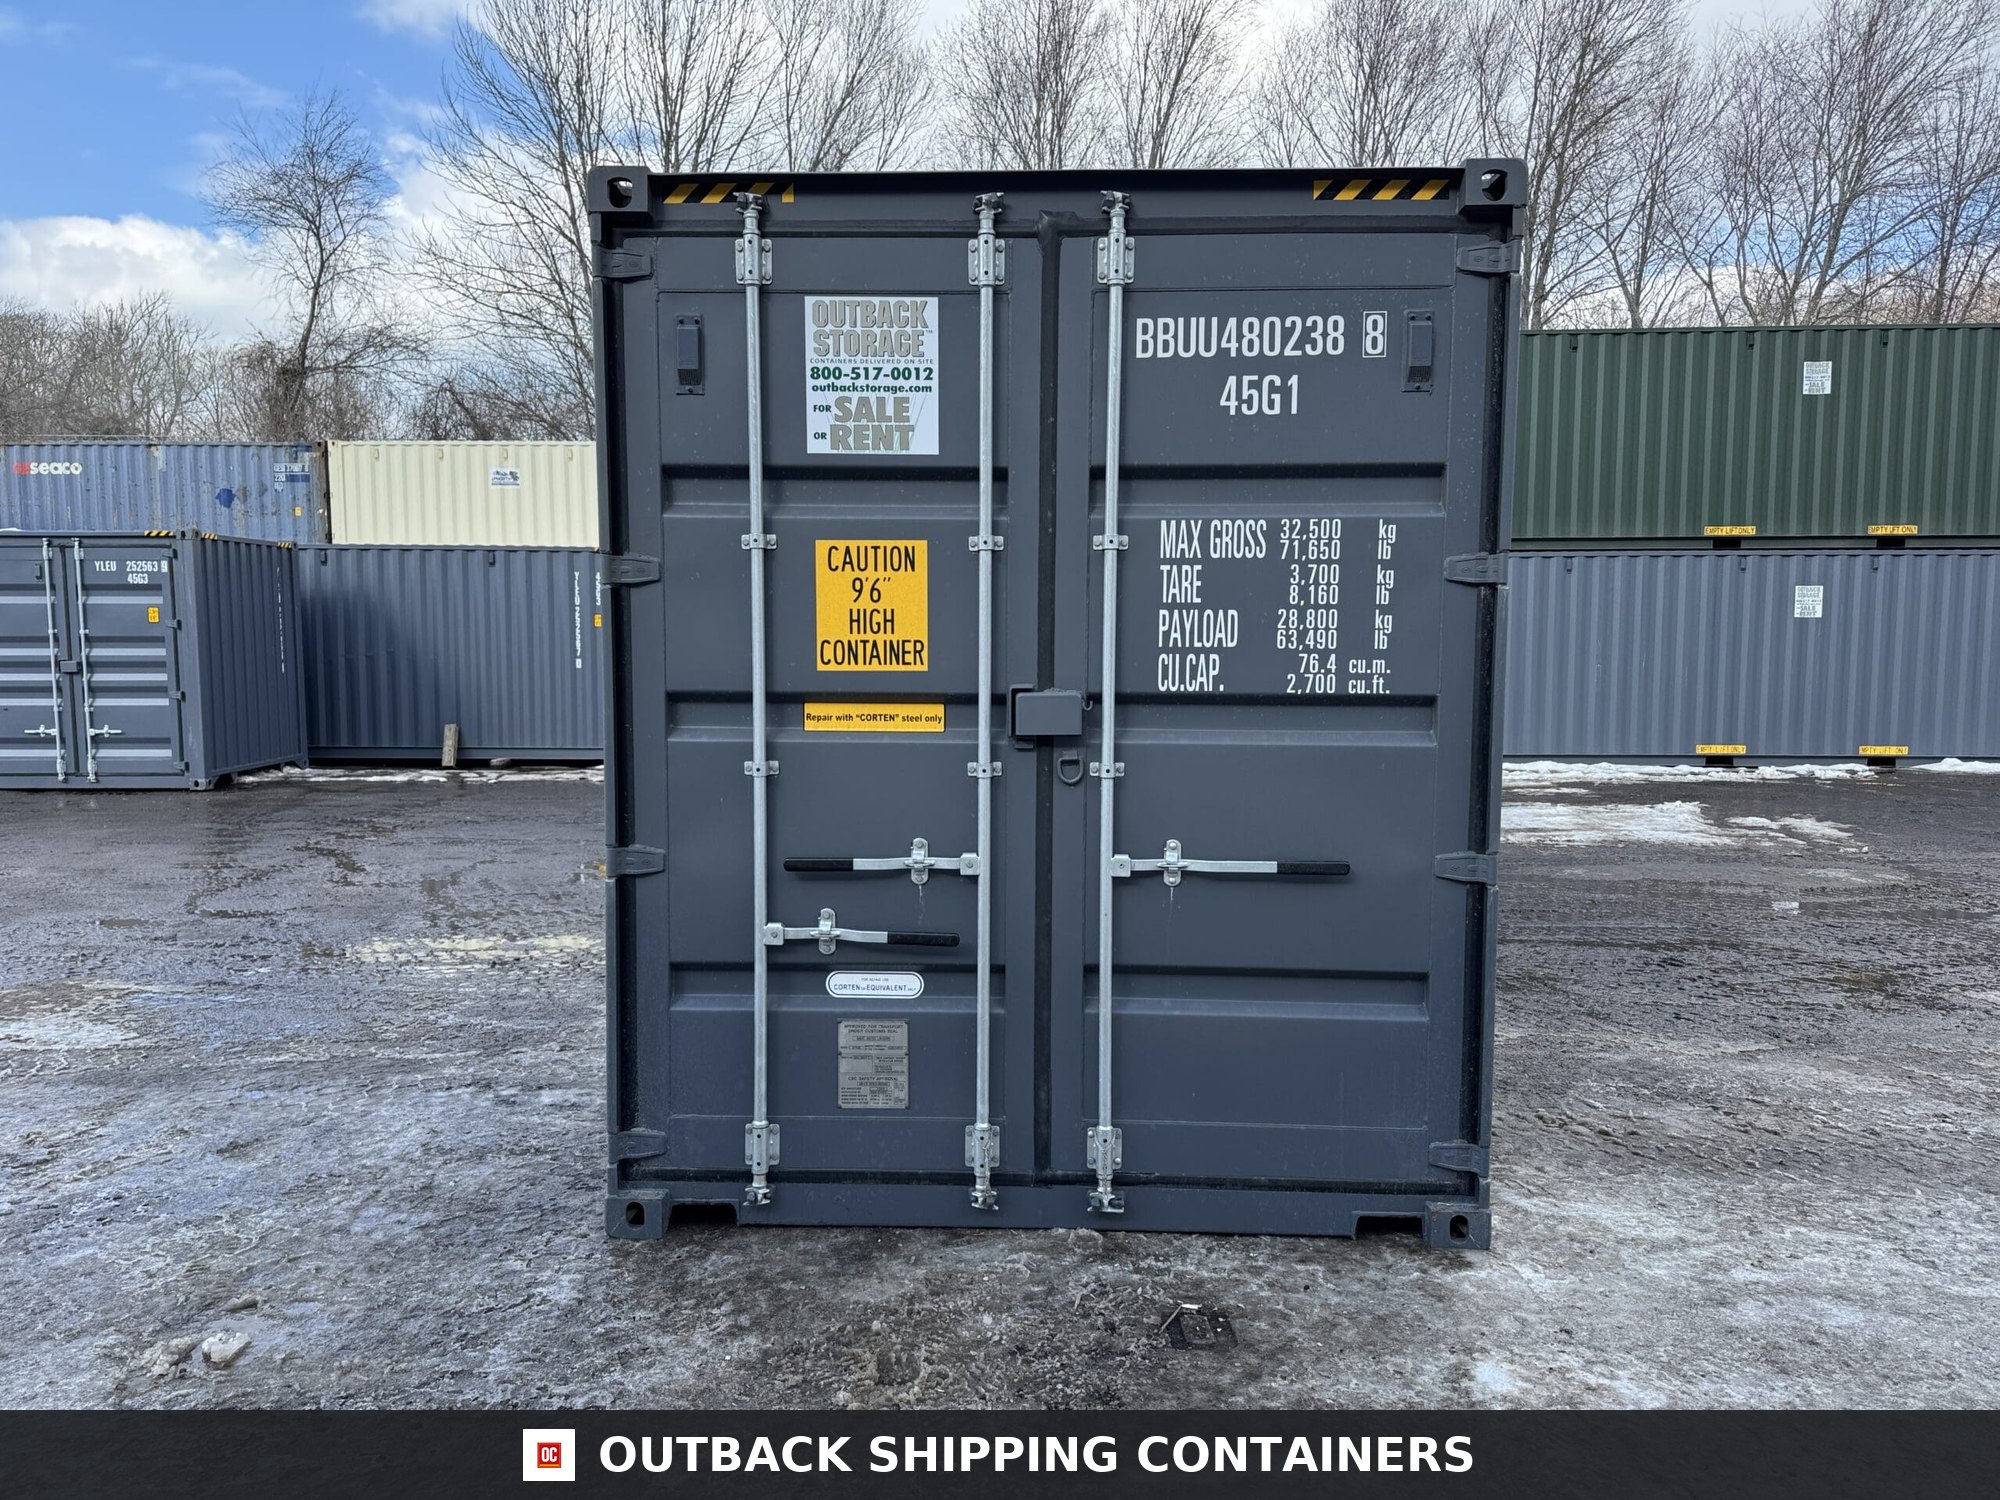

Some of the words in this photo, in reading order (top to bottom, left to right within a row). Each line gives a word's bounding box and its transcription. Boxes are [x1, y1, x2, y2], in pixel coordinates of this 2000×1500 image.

[811, 300, 929, 329] OUTBACK
[812, 329, 925, 358] STORAGE
[1135, 315, 1346, 359] BBUU480238
[1364, 313, 1385, 356] 8
[810, 366, 934, 381] 800-517-0012
[811, 382, 932, 394] outbackstorage.com
[1219, 374, 1299, 416] 45G1
[813, 405, 832, 413] FOR
[834, 396, 910, 423] SALE
[813, 432, 827, 440] OR
[829, 424, 915, 451] RENT
[1160, 519, 1202, 559] MAX
[1209, 519, 1267, 559] GROSS
[1280, 518, 1342, 540] 32,500
[1378, 518, 1397, 544] kg
[826, 545, 916, 573] CAUTION
[1279, 539, 1341, 561] 71,650
[1377, 539, 1392, 560] lb
[94, 560, 117, 572] YLEU
[126, 560, 159, 572] 252563
[1290, 564, 1340, 586] 3,700
[1376, 564, 1395, 589] kg
[1160, 564, 1202, 604] TARE
[1289, 585, 1339, 606] 8,160
[1375, 585, 1390, 605] lb
[849, 608, 895, 635] HIGH
[1158, 609, 1239, 648] PAYLOAD
[1277, 609, 1338, 631] 28,800
[1374, 609, 1393, 634] kg
[819, 639, 925, 667] CONTAINER
[1276, 629, 1337, 651] 63,490
[1374, 629, 1388, 650] lb
[1157, 653, 1225, 692] CU.CAP.
[1298, 653, 1337, 674] 76.4
[1348, 659, 1391, 674] cu.m.
[1286, 674, 1336, 695] 2,700
[1348, 675, 1391, 695] cu.ft.
[806, 713, 833, 723] Repair
[836, 713, 854, 721] with
[901, 714, 923, 722] steel
[924, 714, 943, 724] only
